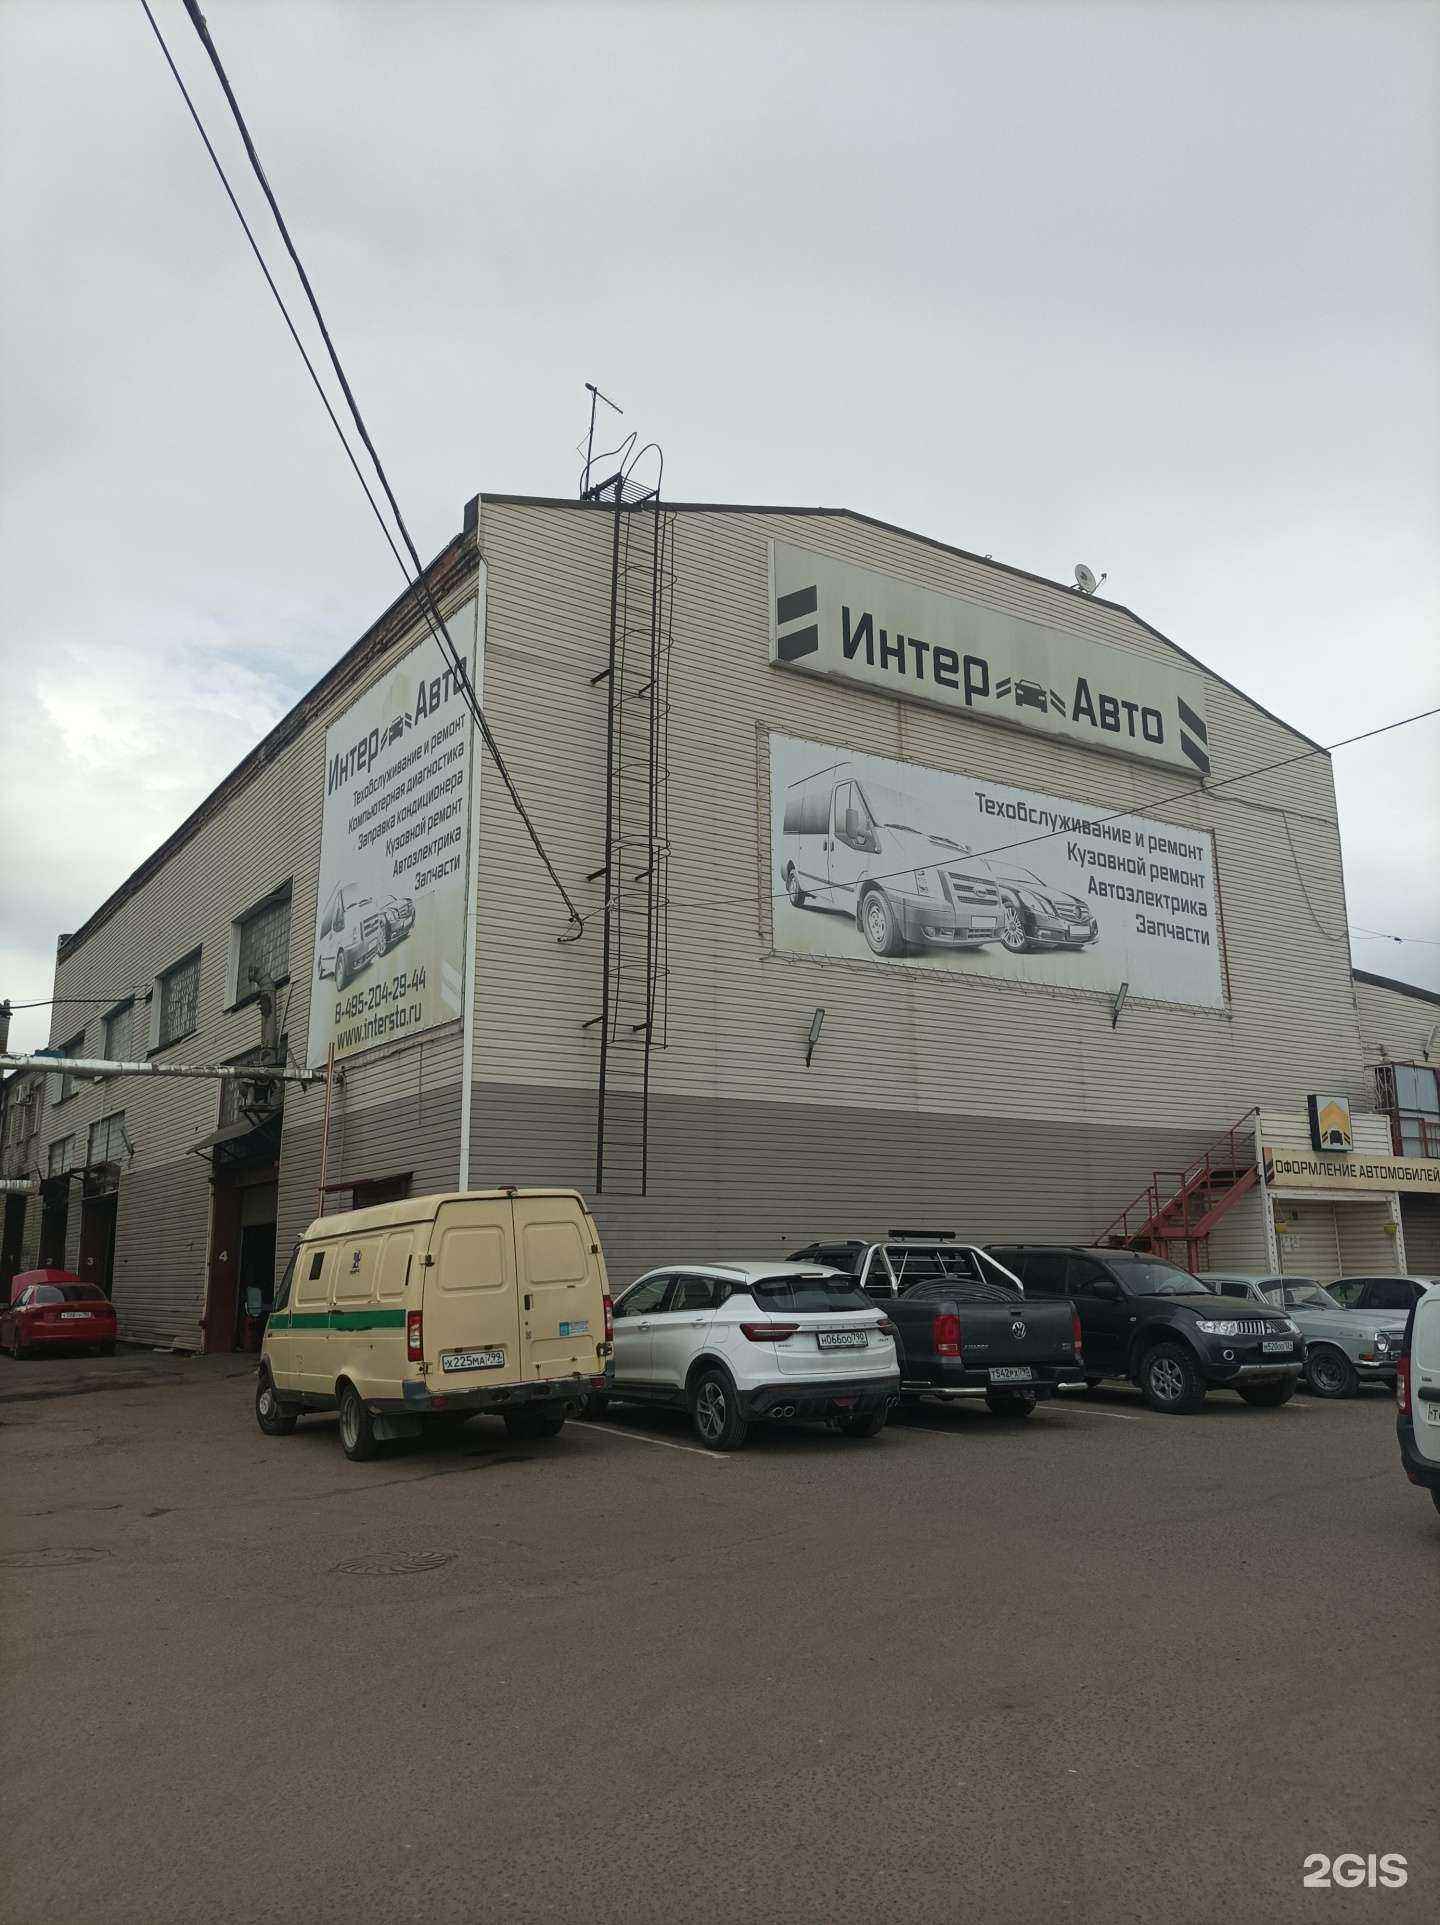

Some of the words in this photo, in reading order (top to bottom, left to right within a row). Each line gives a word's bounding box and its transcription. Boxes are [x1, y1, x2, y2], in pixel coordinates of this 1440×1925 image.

[842, 606, 990, 705] Интер
[1072, 677, 1164, 745] Авто
[328, 728, 378, 796] Интер
[415, 656, 467, 726] Авто
[353, 745, 423, 808] Техобслуживание
[423, 743, 430, 756] и
[430, 713, 466, 753] ремонт
[348, 786, 406, 834] Компьютерная
[406, 742, 464, 791] диагностика
[358, 815, 396, 850] Заправка
[396, 770, 463, 823] кондиционера
[385, 820, 426, 858] Кузовной
[427, 798, 463, 836] ремонт
[393, 826, 462, 877] Автоэлектрика
[975, 792, 1131, 843] Техобслуживание
[1135, 832, 1144, 848] и
[1148, 835, 1203, 861] ремонт
[415, 855, 461, 890] Запчасти
[1067, 842, 1146, 876] Кузовной
[1150, 863, 1205, 889] ремонт
[1088, 876, 1207, 917] Автоэлектрика
[1135, 914, 1210, 946] Запчасти
[337, 1003, 422, 1050] www.intersto.ru
[1275, 1160, 1357, 1178] ОФОРМЛЕНИЕ
[219, 1250, 228, 1262] 4
